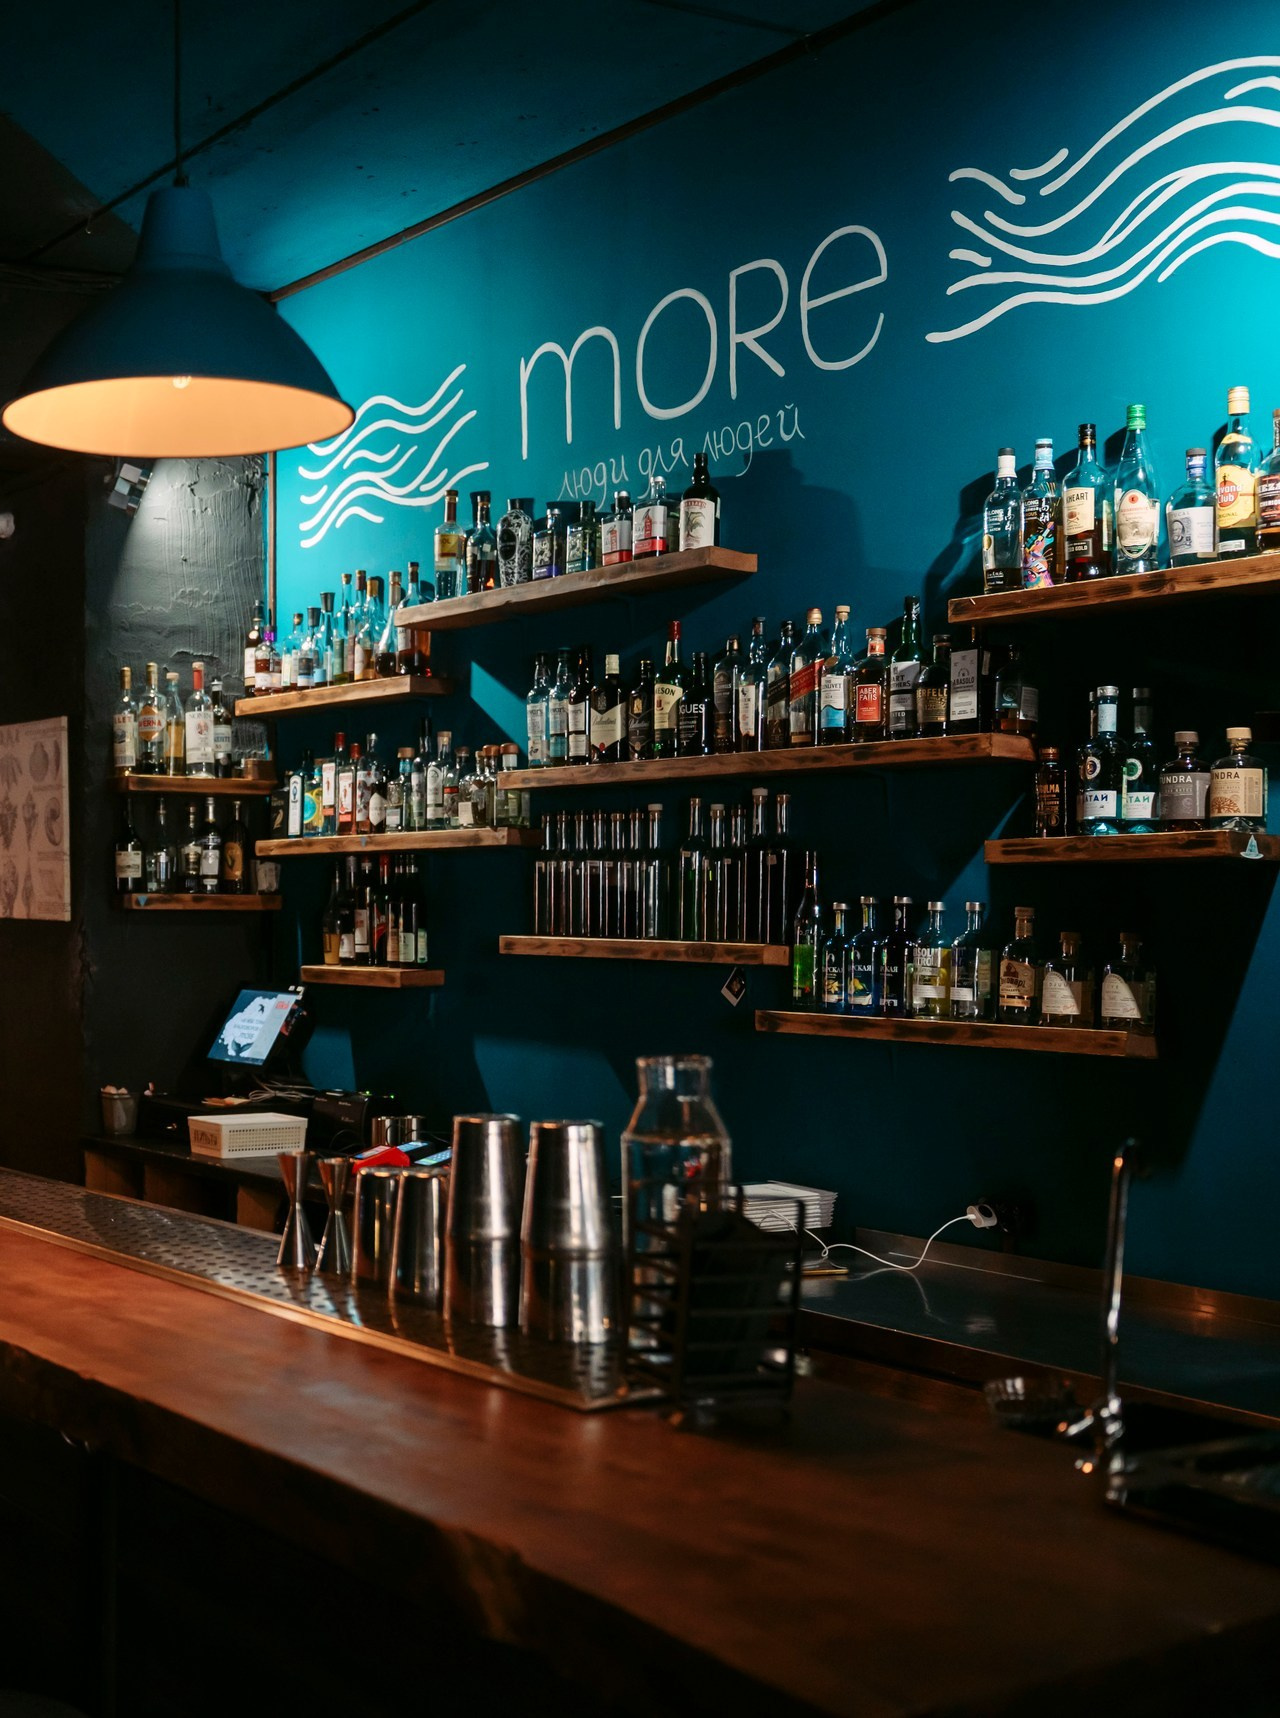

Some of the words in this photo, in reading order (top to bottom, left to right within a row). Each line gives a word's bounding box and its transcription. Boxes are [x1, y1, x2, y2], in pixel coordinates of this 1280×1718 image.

[556, 454, 629, 513] люди
[637, 436, 690, 500] для
[701, 402, 806, 478] людей
